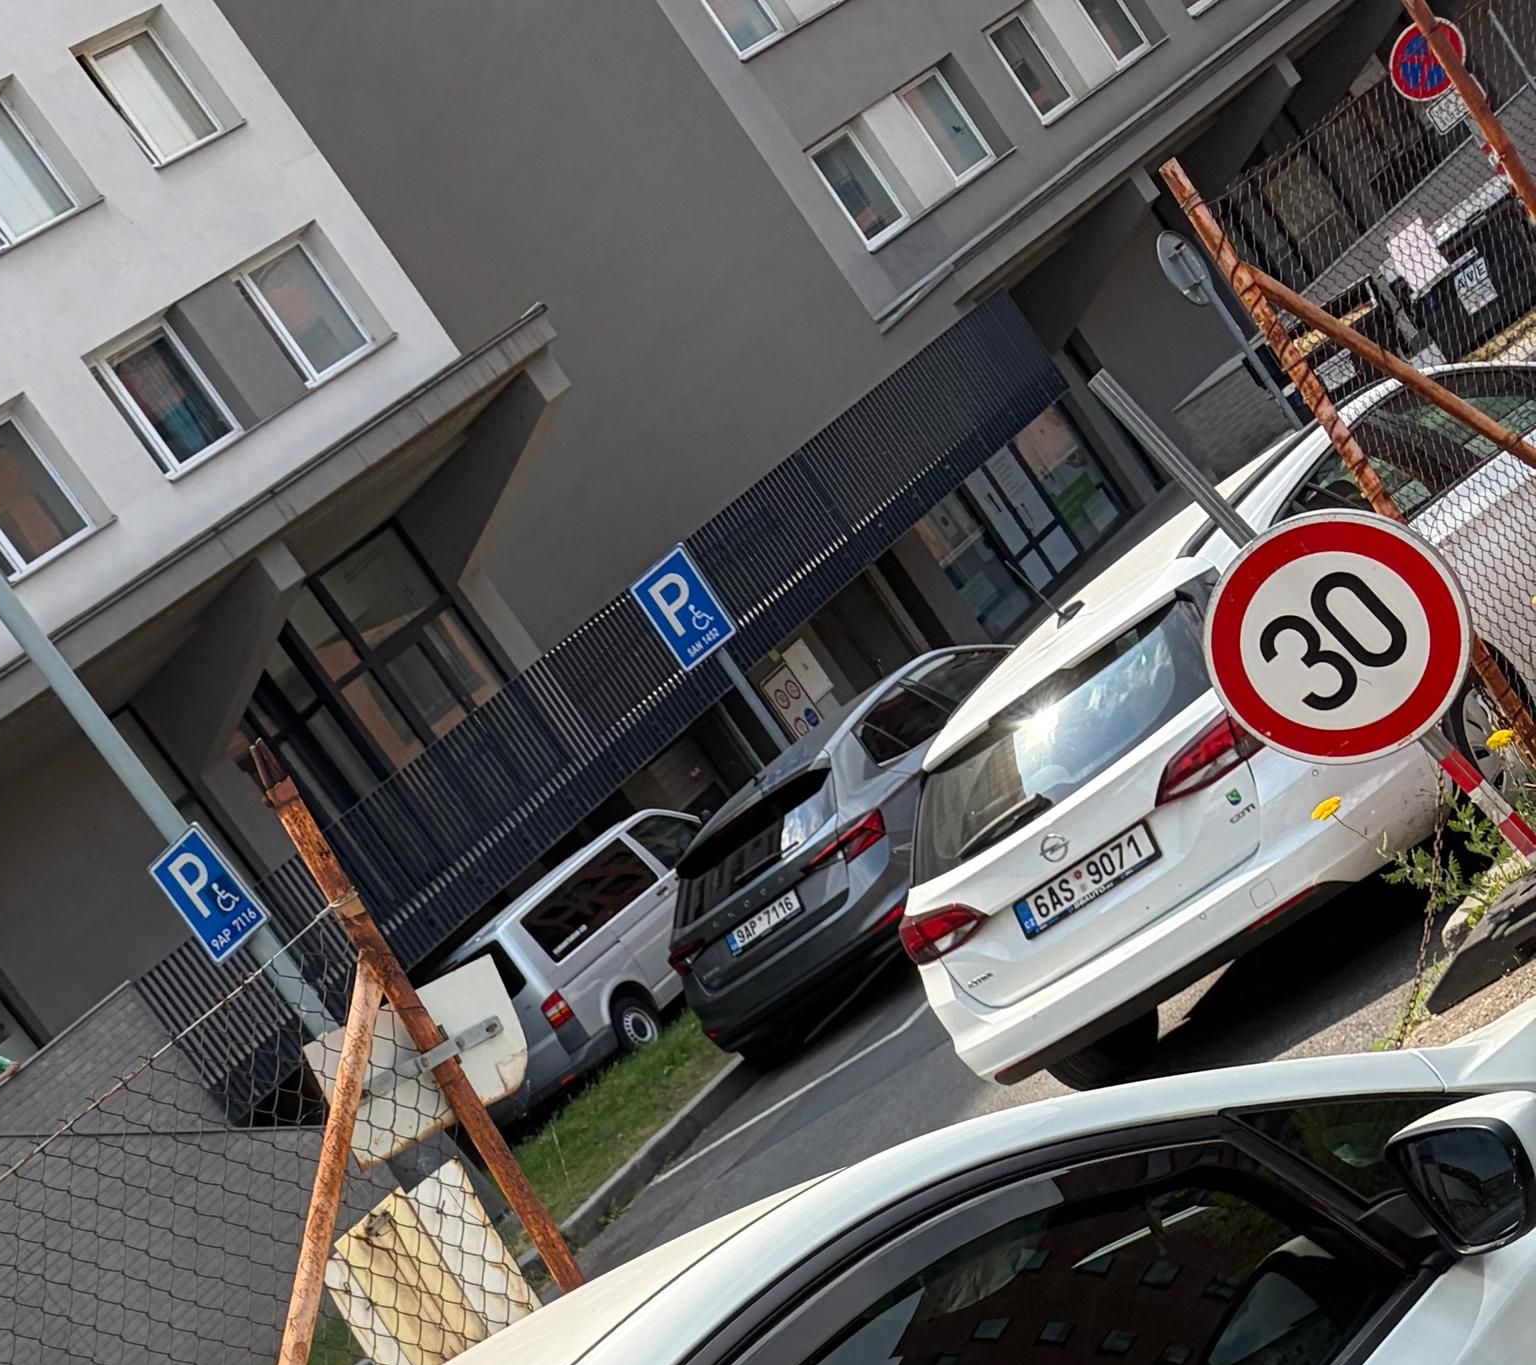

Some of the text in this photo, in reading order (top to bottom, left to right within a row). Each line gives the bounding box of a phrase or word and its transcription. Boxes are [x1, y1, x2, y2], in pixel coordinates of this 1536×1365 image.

[648, 572, 690, 637] P
[1259, 571, 1408, 711] 30
[167, 852, 212, 919] P
[1034, 834, 1143, 919] 6AS 9071
[210, 908, 257, 951] 9AP 7116
[762, 896, 794, 925] 7116
